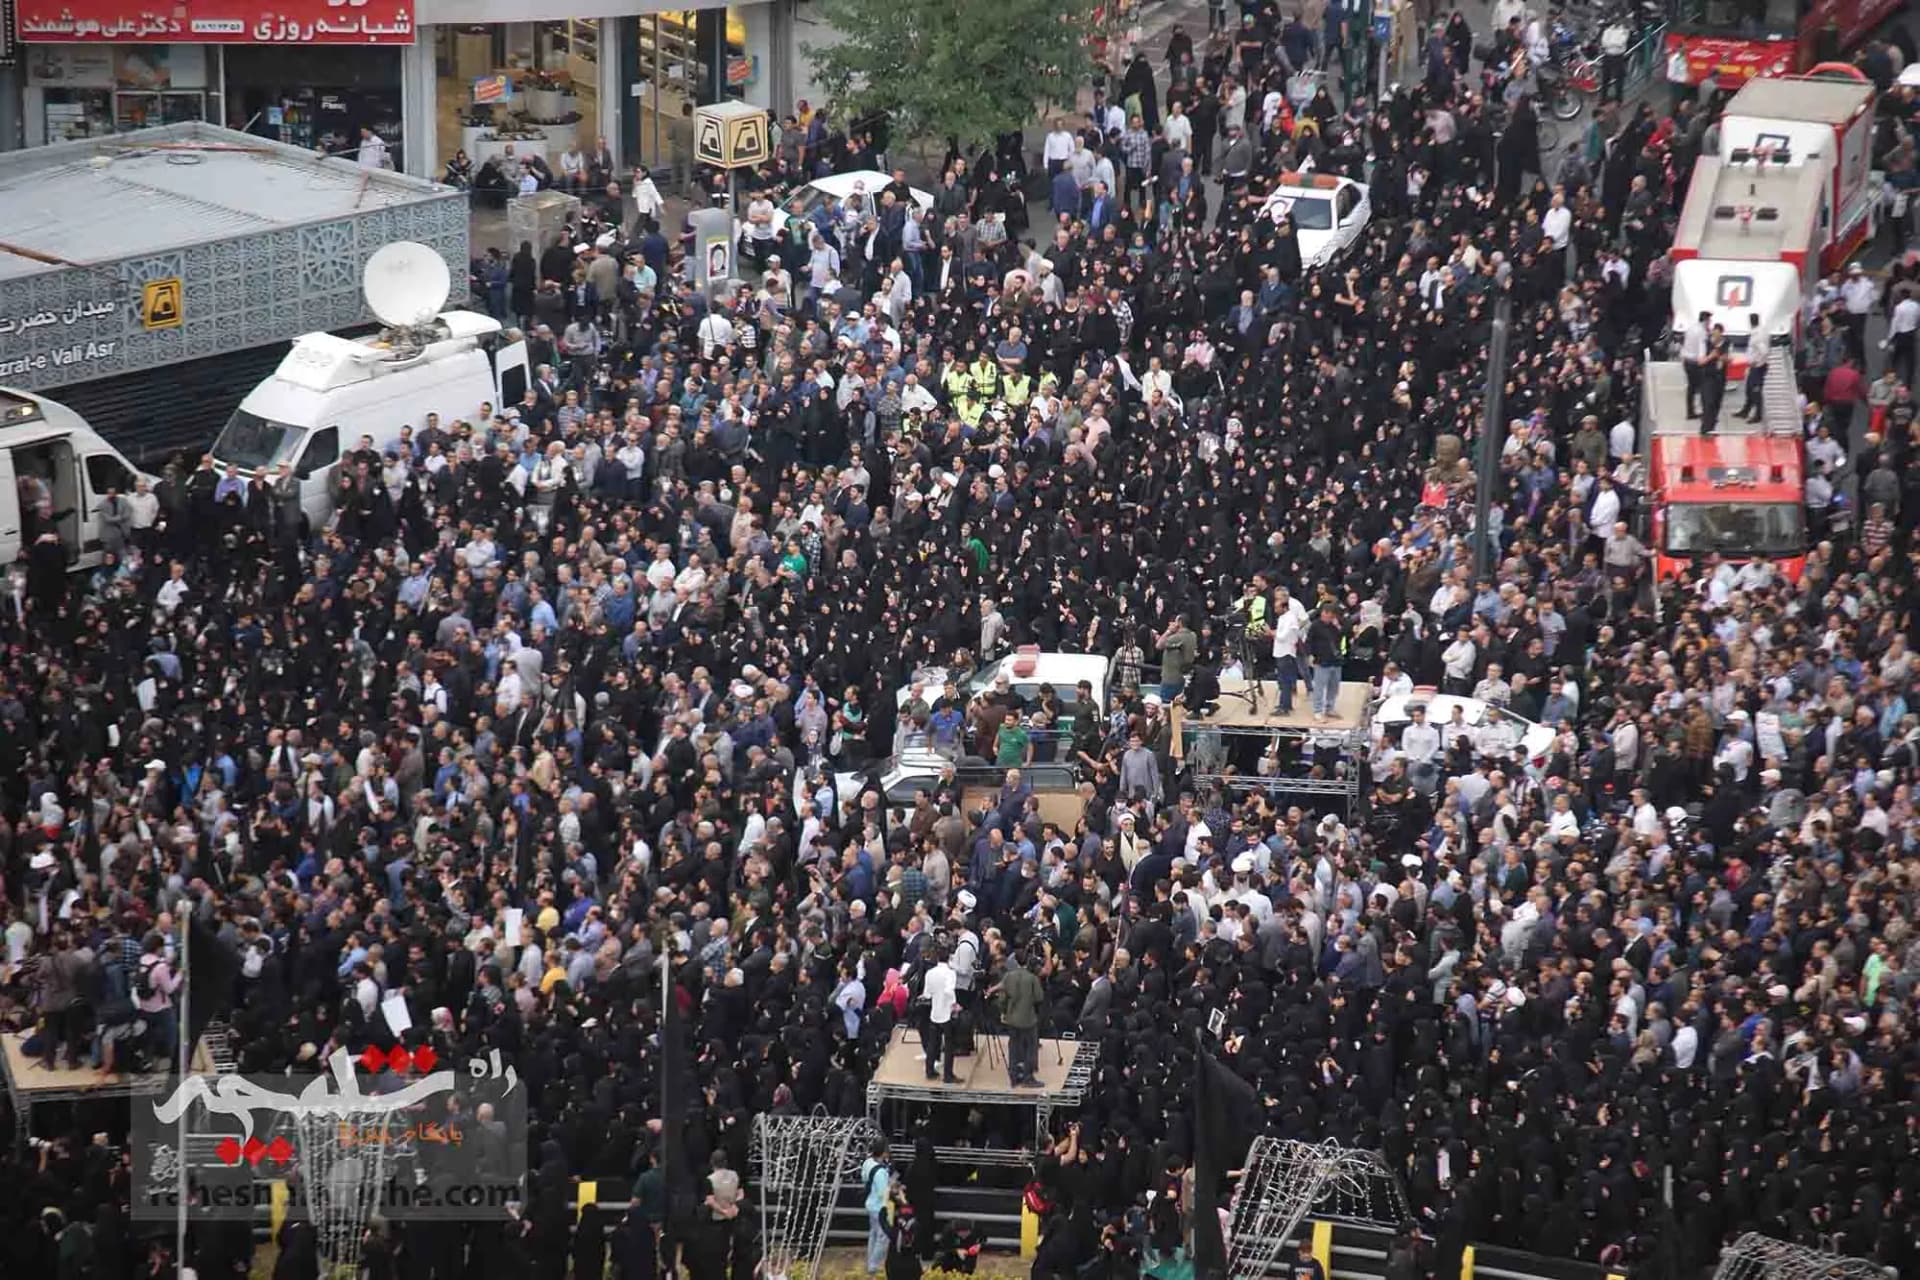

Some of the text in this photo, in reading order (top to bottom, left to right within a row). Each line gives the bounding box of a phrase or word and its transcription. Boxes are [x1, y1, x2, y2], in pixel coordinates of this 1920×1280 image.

[22, 8, 182, 37] دکتر علی هوشمند
[61, 300, 116, 325] میدان
[51, 345, 82, 366] Vali
[84, 342, 117, 360] Asr
